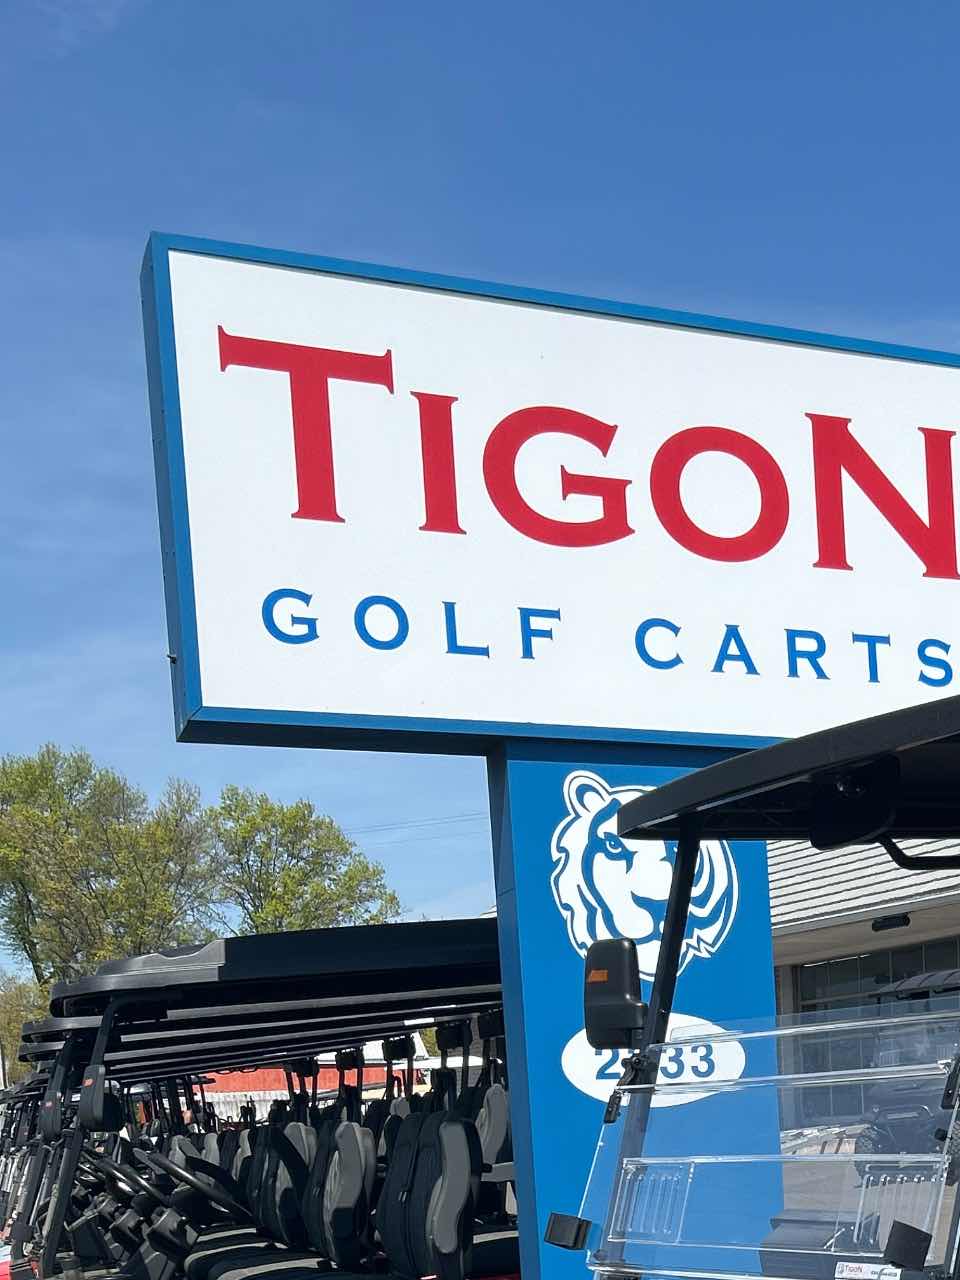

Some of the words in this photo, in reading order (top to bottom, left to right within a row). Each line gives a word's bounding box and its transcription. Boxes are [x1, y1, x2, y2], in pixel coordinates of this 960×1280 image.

[261, 587, 561, 661] GOLF
[634, 617, 954, 688] CARTS
[595, 1043, 715, 1080] 233
